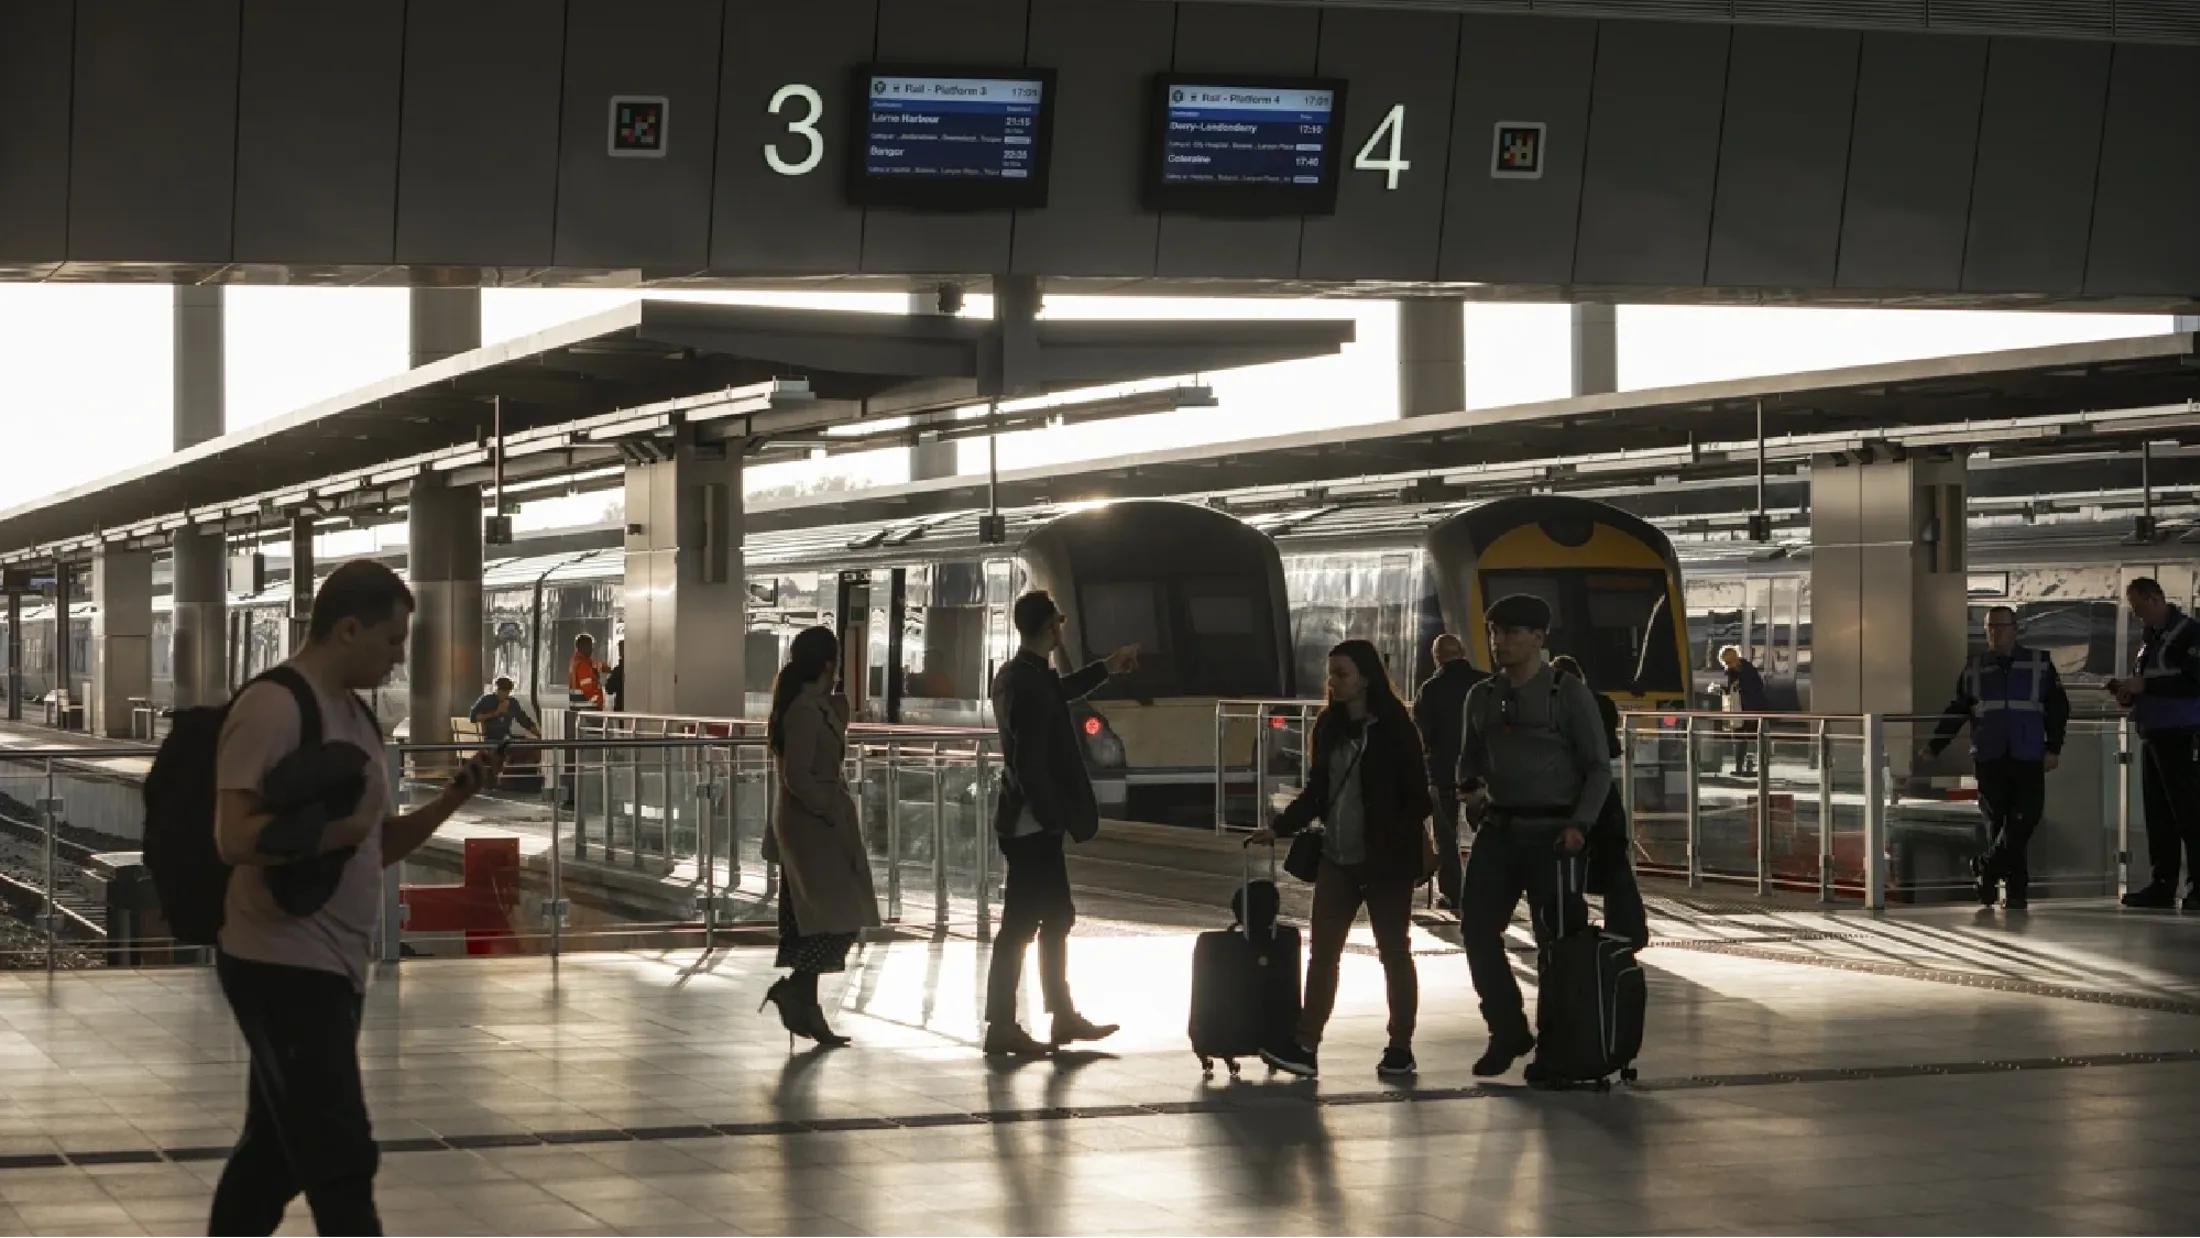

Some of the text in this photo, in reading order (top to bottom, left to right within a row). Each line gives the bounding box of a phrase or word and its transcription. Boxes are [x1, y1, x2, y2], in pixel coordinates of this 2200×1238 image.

[905, 83, 925, 94] Rail
[935, 84, 978, 96] Platform
[1012, 87, 1038, 97] 17:01
[1202, 92, 1220, 102] Rail
[1230, 93, 1272, 105] Platform
[902, 113, 940, 124] Harbour
[764, 84, 824, 176] 3
[869, 145, 905, 157] Bangor
[1354, 105, 1410, 190] 4
[1168, 154, 1212, 164] Coleraine
